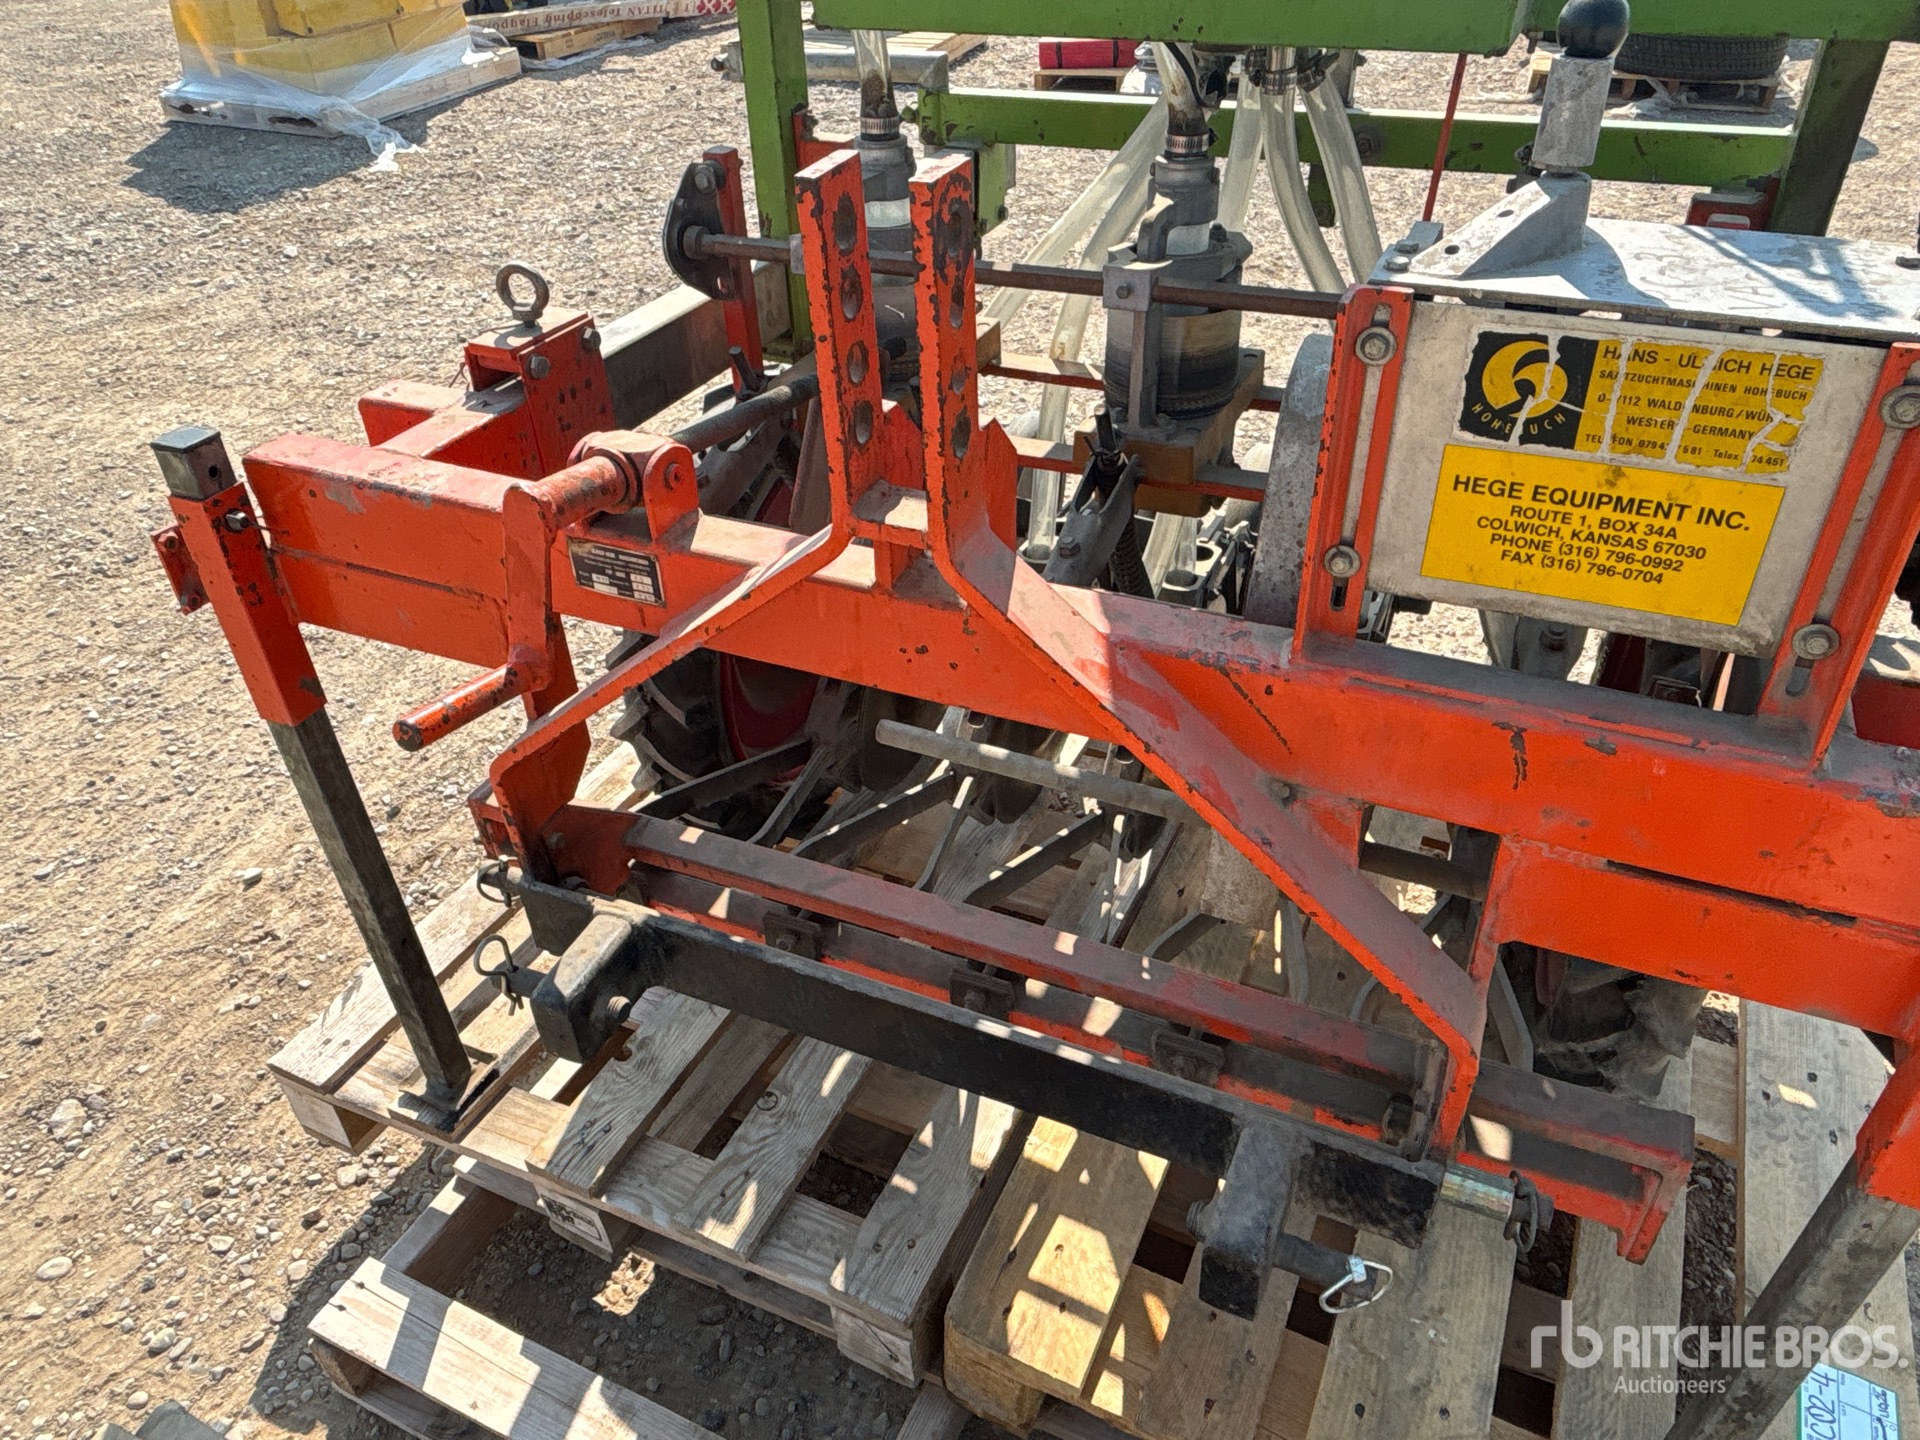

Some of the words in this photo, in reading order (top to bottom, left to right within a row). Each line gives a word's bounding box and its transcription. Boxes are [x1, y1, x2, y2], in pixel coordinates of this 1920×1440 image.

[1678, 353, 1752, 375] ULICH
[1759, 362, 1816, 381] HEGE
[1743, 385, 1807, 401] HOHBUCH
[1471, 402, 1566, 435] HOHEUCH
[1626, 415, 1757, 441] WESTER-GERMANY
[1585, 433, 1633, 447] TELFON
[1453, 475, 1524, 500] HEGE
[1532, 484, 1691, 522] EQUIPMENT
[1696, 507, 1750, 531] INC.
[1477, 516, 1564, 541] COLWICH,
[1570, 529, 1648, 551] KANSAS
[1653, 541, 1706, 560] 67030
[1509, 505, 1573, 525] ROUTE
[1579, 514, 1592, 530] 1,
[1598, 518, 1638, 534] BOX
[1643, 523, 1677, 540] 34A
[1489, 533, 1553, 553] PHONE
[1558, 541, 1599, 561] (316)
[1605, 550, 1684, 572] 796-0992
[1500, 550, 1534, 566] FAX
[1540, 554, 1582, 574] (316)
[1586, 562, 1664, 584] 796-0704
